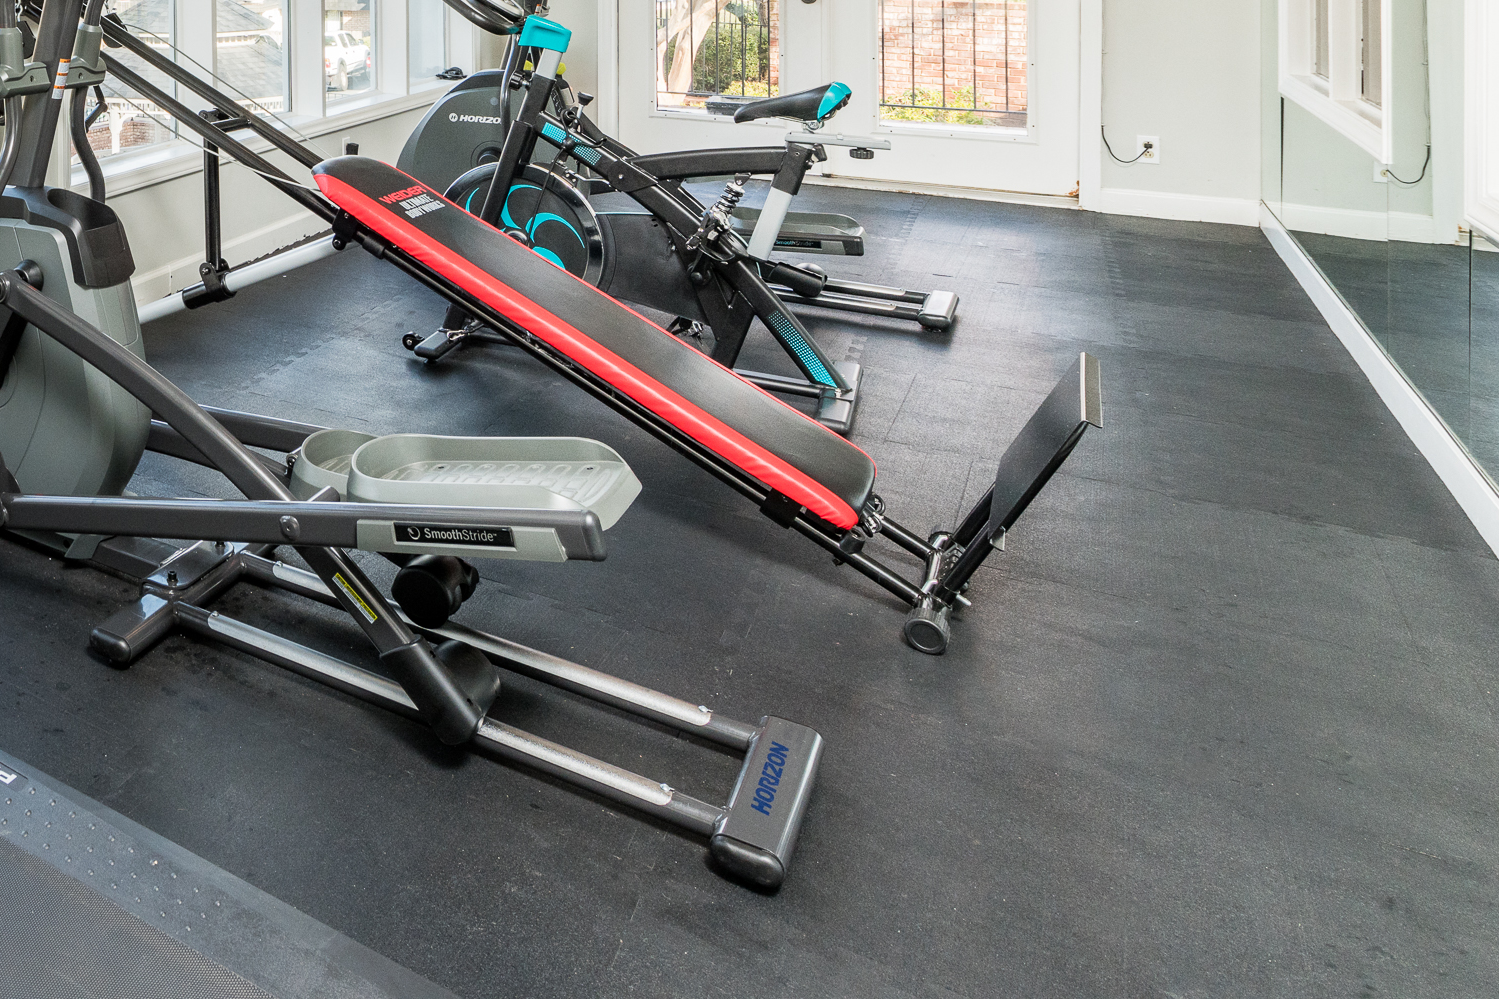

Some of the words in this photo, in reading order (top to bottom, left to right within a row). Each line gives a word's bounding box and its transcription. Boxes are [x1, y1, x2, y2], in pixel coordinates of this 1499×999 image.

[459, 114, 501, 124] HORIZO
[378, 185, 427, 204] WEIDER
[750, 741, 789, 816] HORIZON
